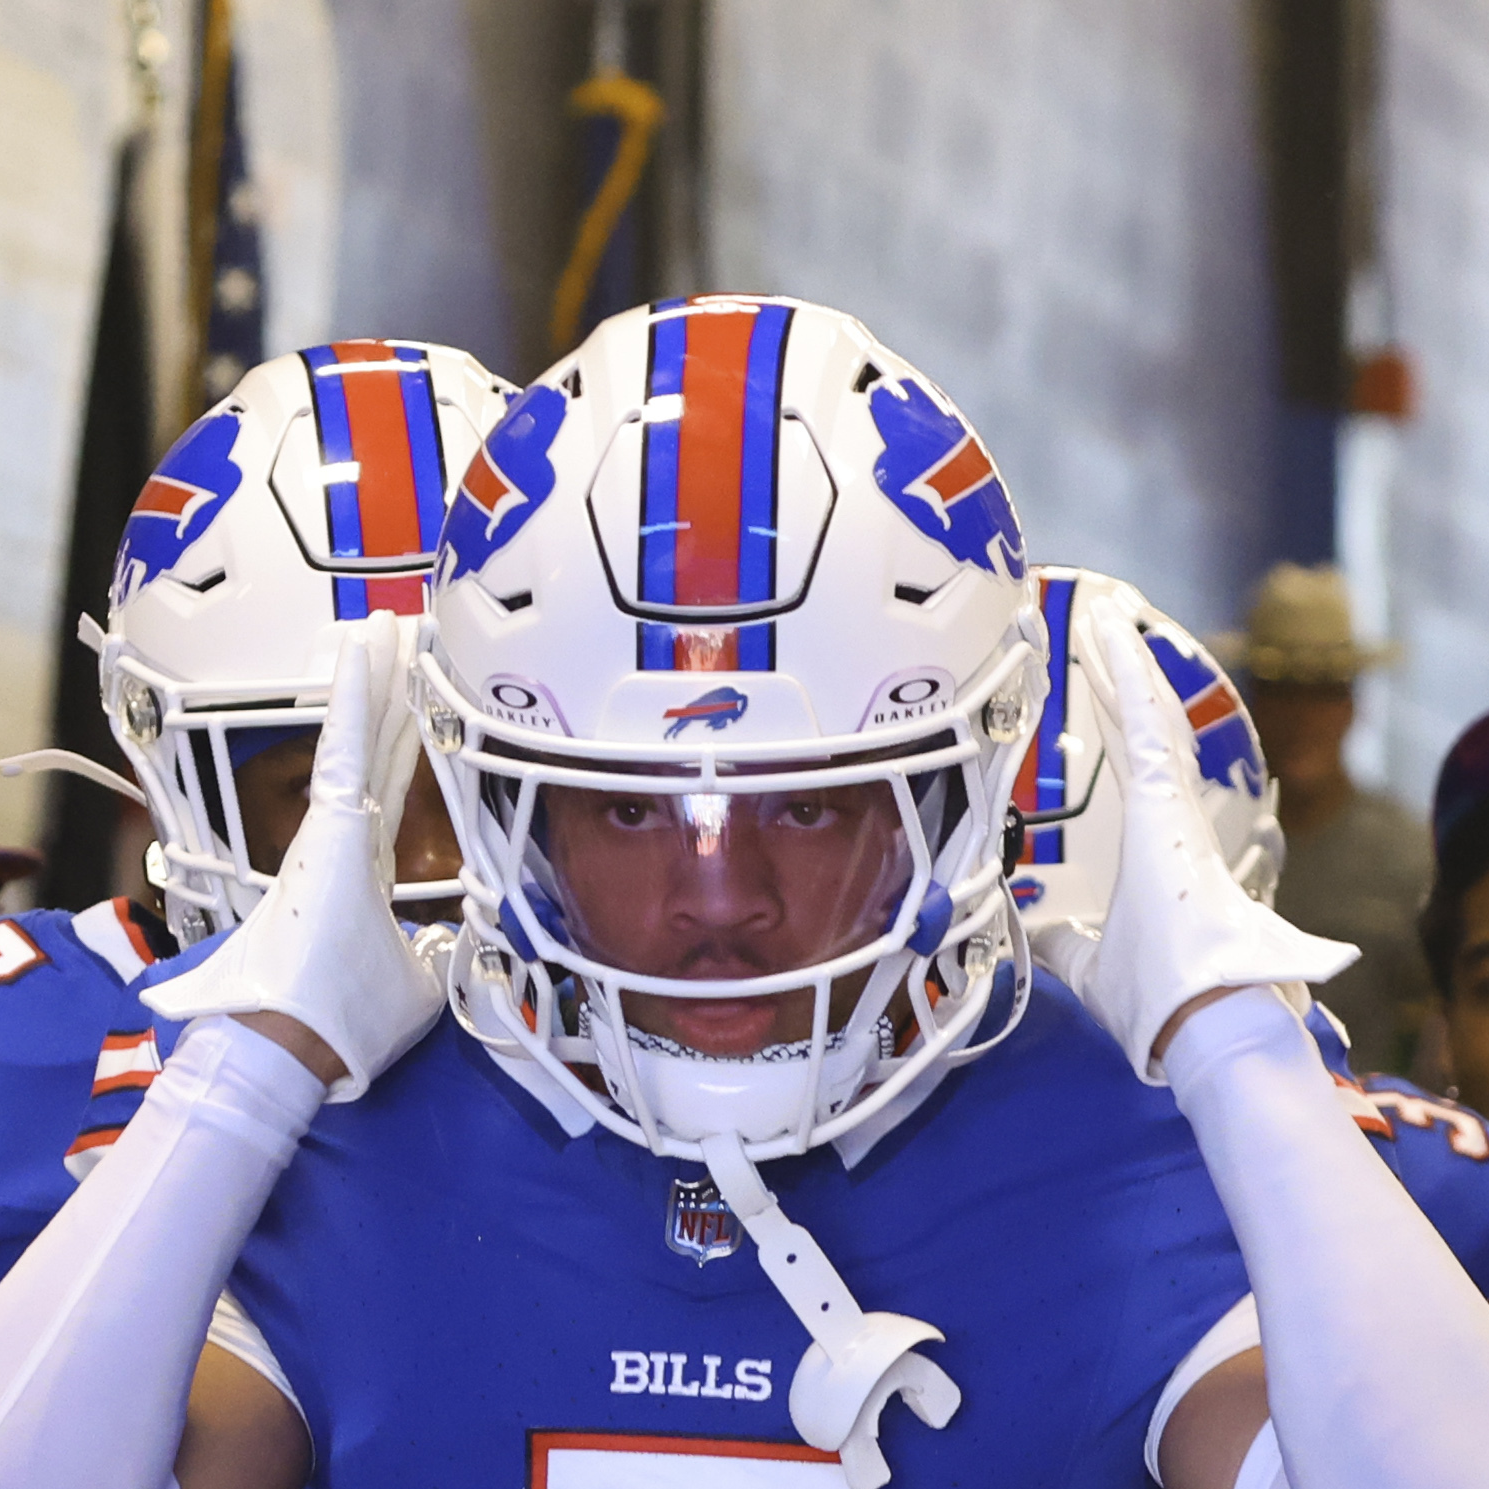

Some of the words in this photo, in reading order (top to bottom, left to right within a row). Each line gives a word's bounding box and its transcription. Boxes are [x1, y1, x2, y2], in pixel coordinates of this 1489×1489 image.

[485, 704, 551, 728] OAKLEY
[874, 699, 948, 724] OAKLEY
[677, 1211, 732, 1246] NFL
[610, 1350, 773, 1402] BILLS
